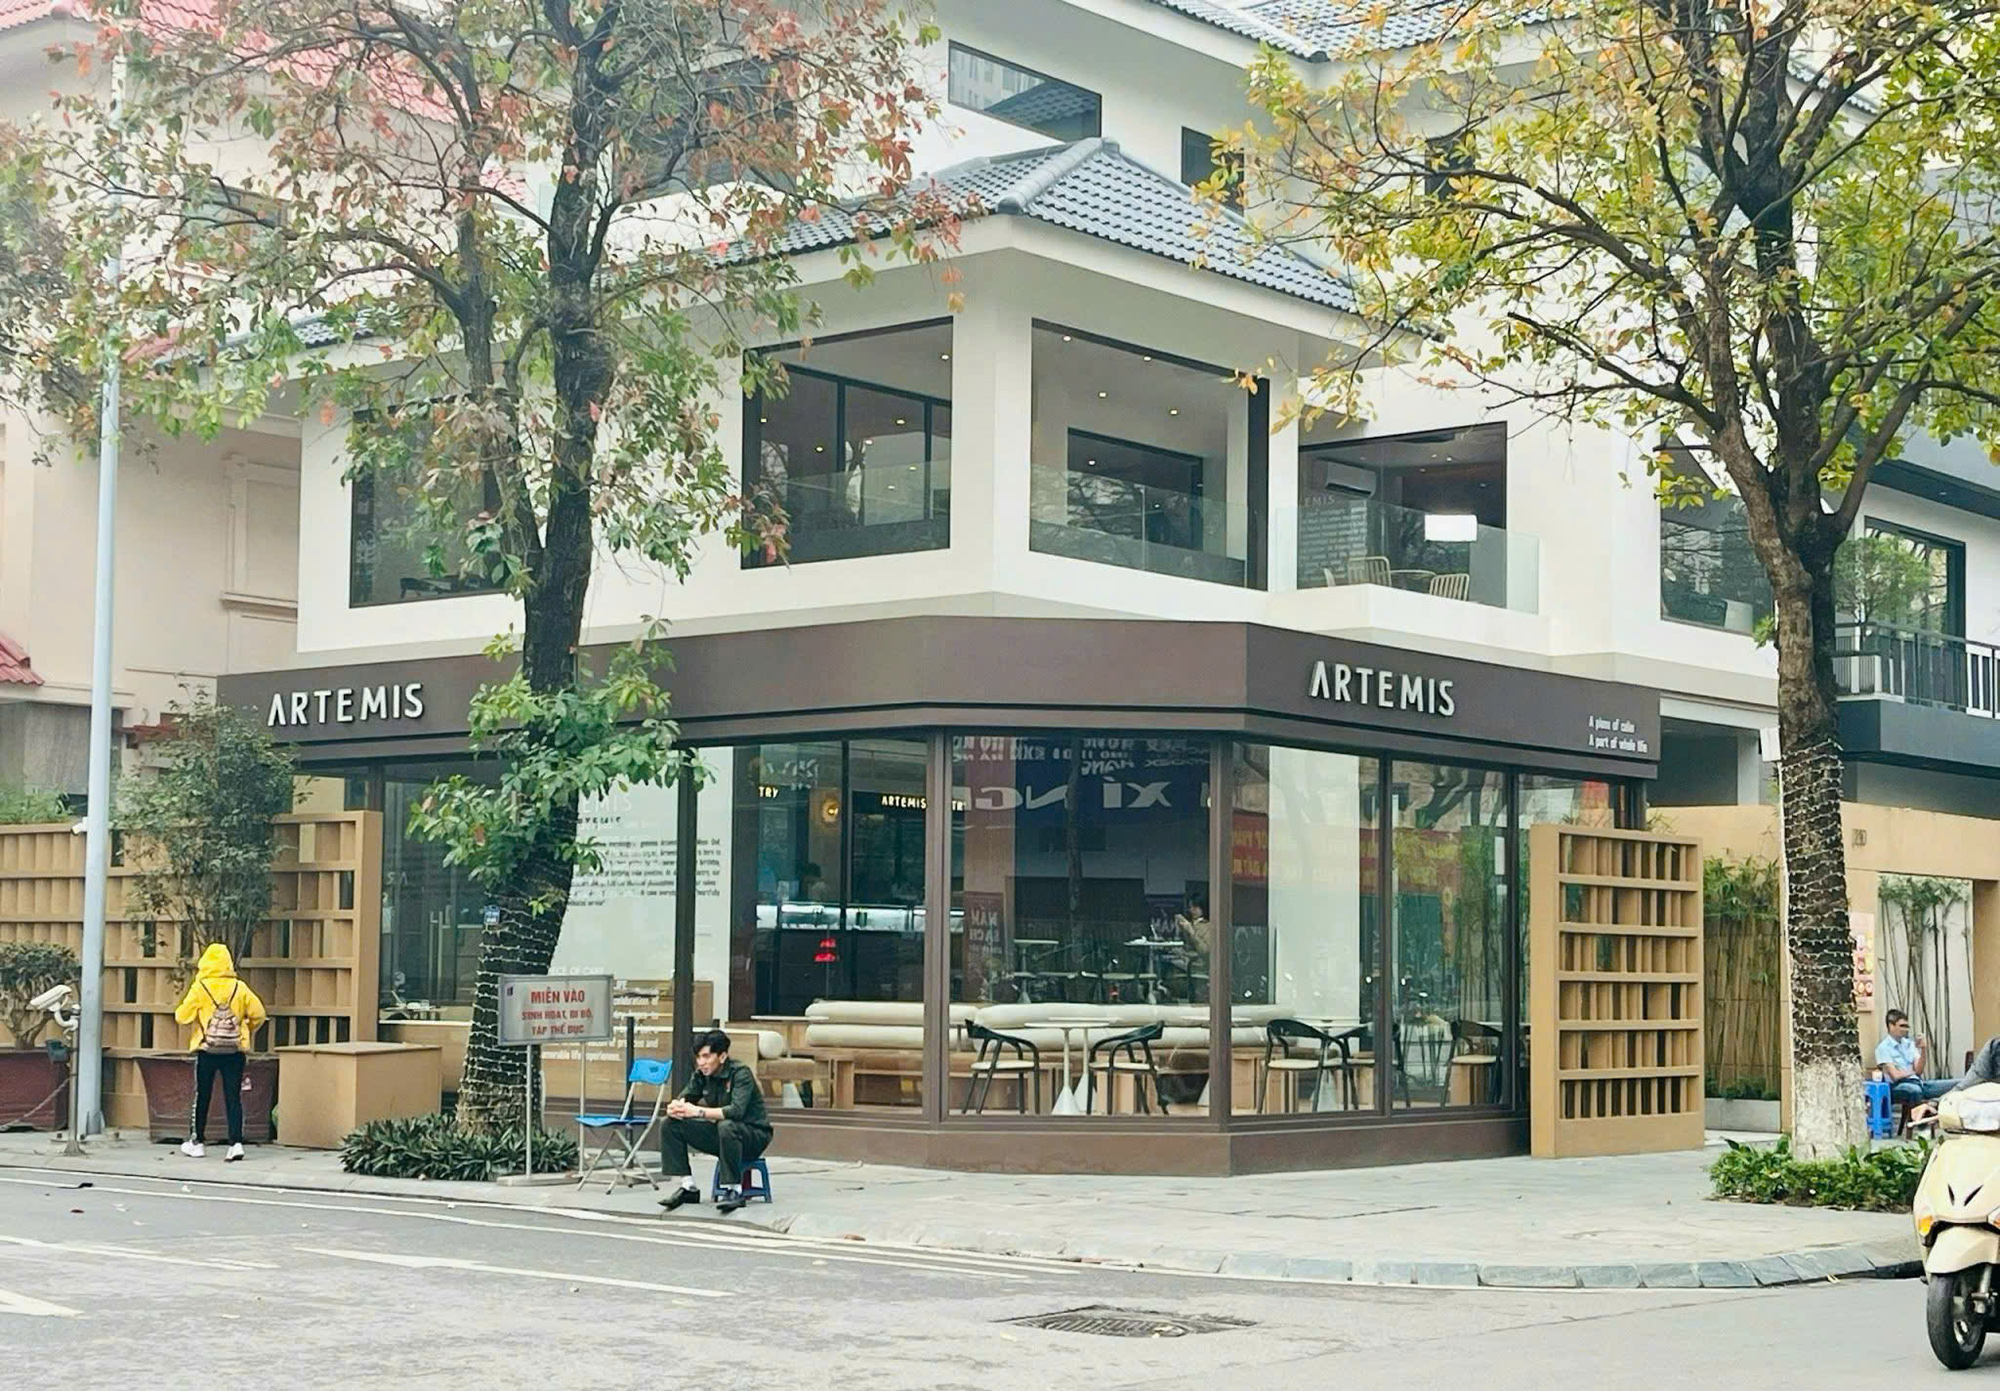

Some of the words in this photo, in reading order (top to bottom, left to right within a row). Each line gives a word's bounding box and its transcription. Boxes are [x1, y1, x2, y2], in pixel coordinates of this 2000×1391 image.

[1310, 660, 1455, 717] ARTEMIS
[267, 682, 424, 727] ARTEMIS
[1588, 715, 1595, 728] A
[1588, 733, 1595, 746] A
[881, 795, 927, 810] ARTEMIS
